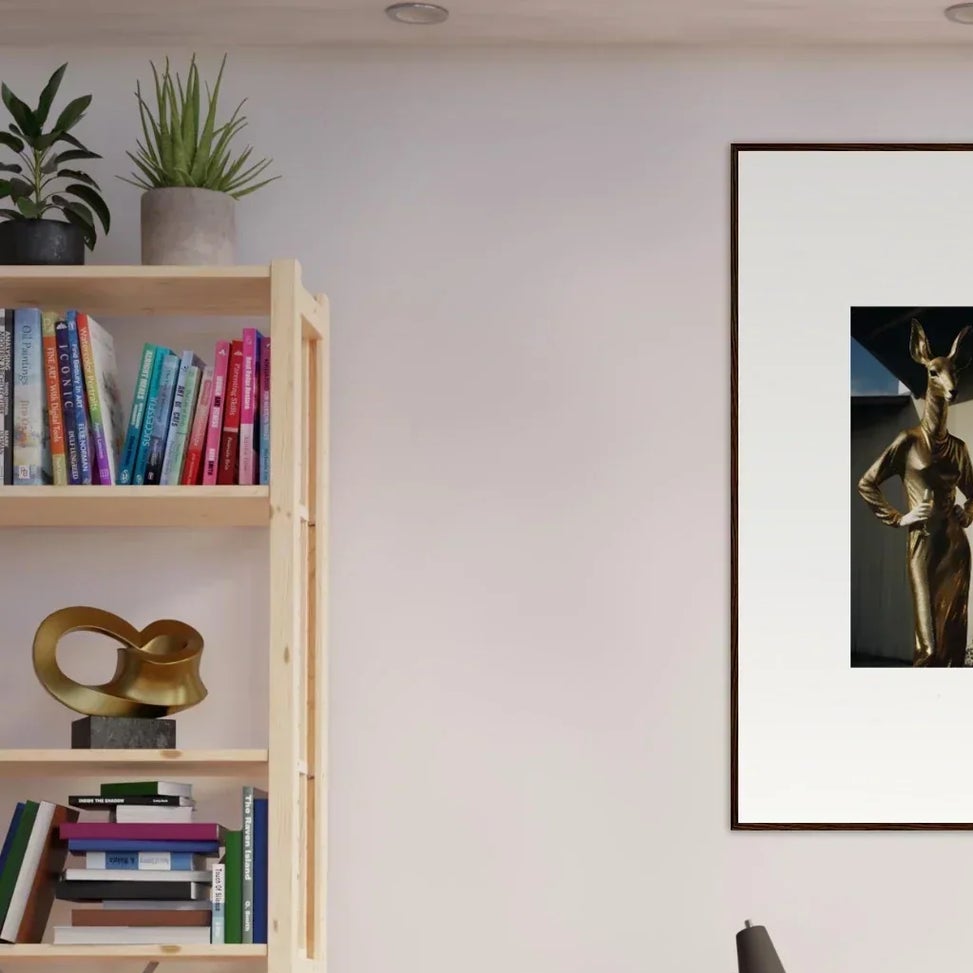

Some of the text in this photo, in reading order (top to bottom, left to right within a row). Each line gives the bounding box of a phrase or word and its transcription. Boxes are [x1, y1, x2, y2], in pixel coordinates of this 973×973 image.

[22, 325, 32, 340] Oil
[47, 347, 57, 362] FINE
[71, 343, 79, 359] Find
[18, 342, 32, 386] Paintings
[48, 365, 58, 379] ART
[72, 360, 81, 384] Beauty
[80, 326, 98, 412] Watercolor Portraits
[59, 344, 74, 408] ICONIC
[49, 385, 59, 402] With
[228, 363, 241, 416] Parenting Skills
[75, 395, 83, 409] ART
[50, 402, 60, 425] Digital
[52, 425, 61, 443] Tools
[215, 868, 223, 885] Touch
